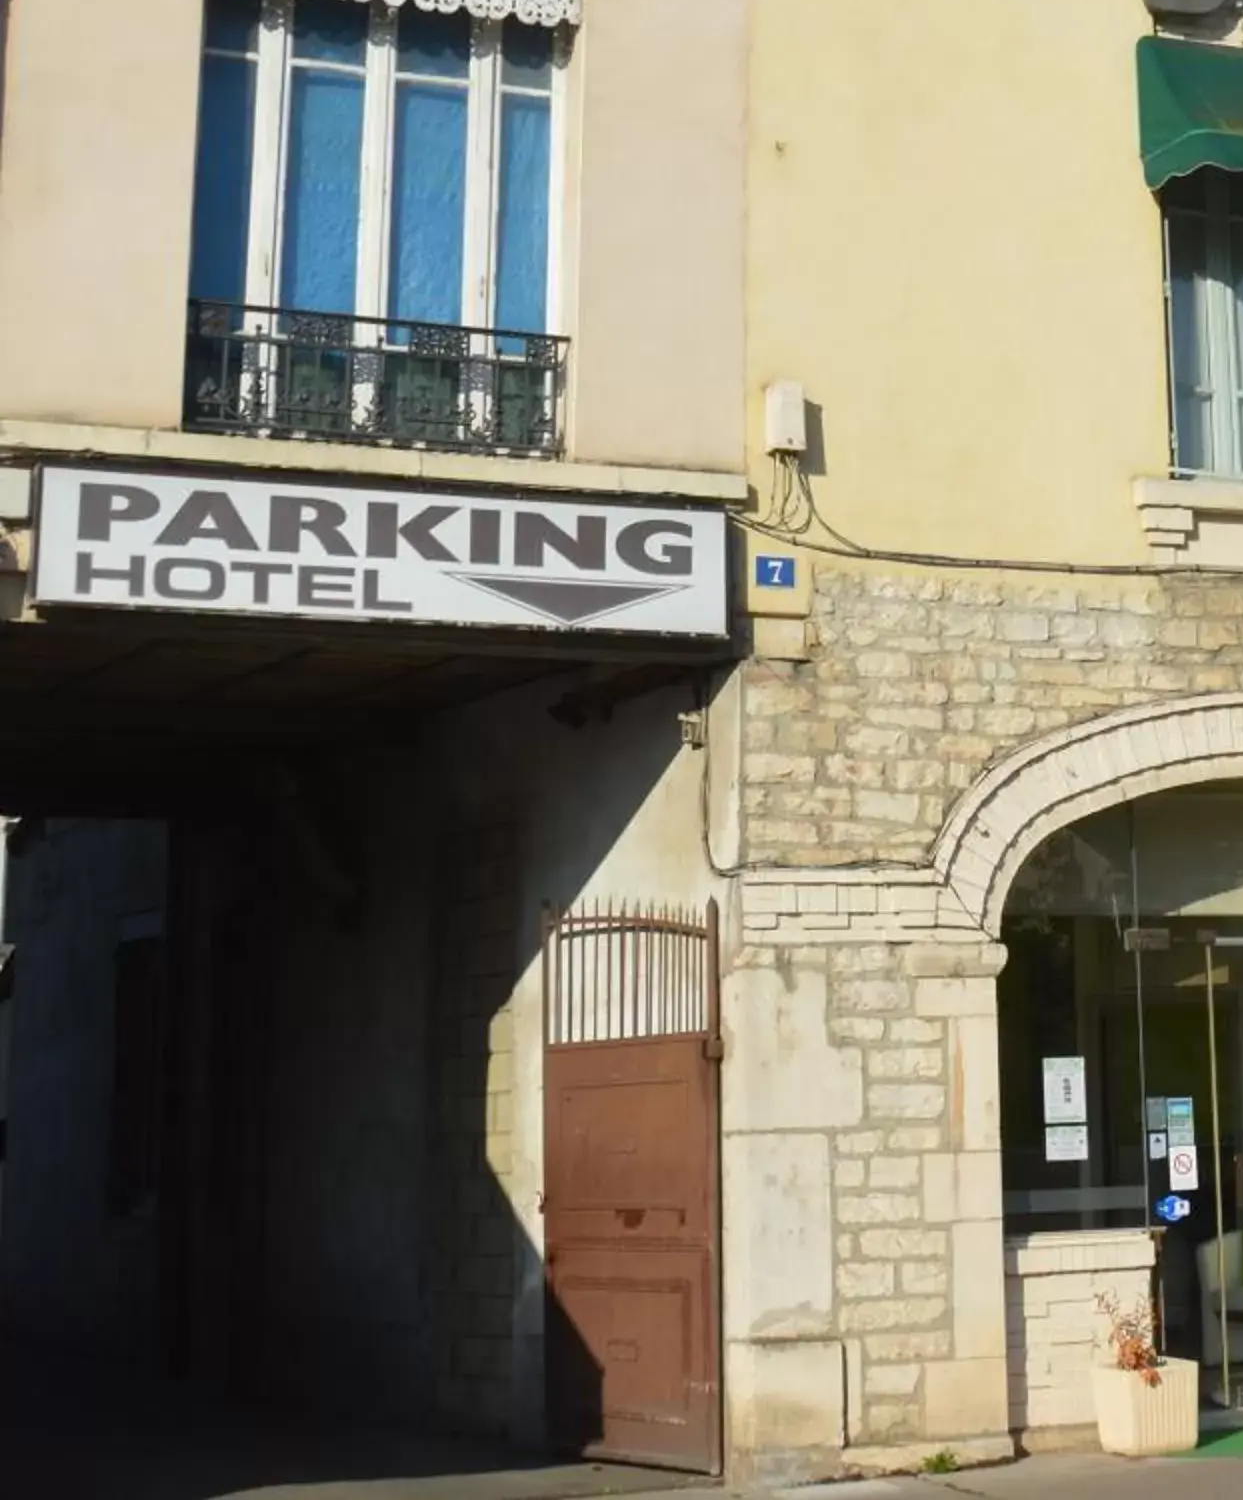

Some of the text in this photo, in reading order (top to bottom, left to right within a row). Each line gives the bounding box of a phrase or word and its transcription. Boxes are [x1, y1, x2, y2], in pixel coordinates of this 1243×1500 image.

[77, 482, 693, 575] PARKING
[75, 551, 413, 612] HOTEL
[767, 560, 784, 583] 7
